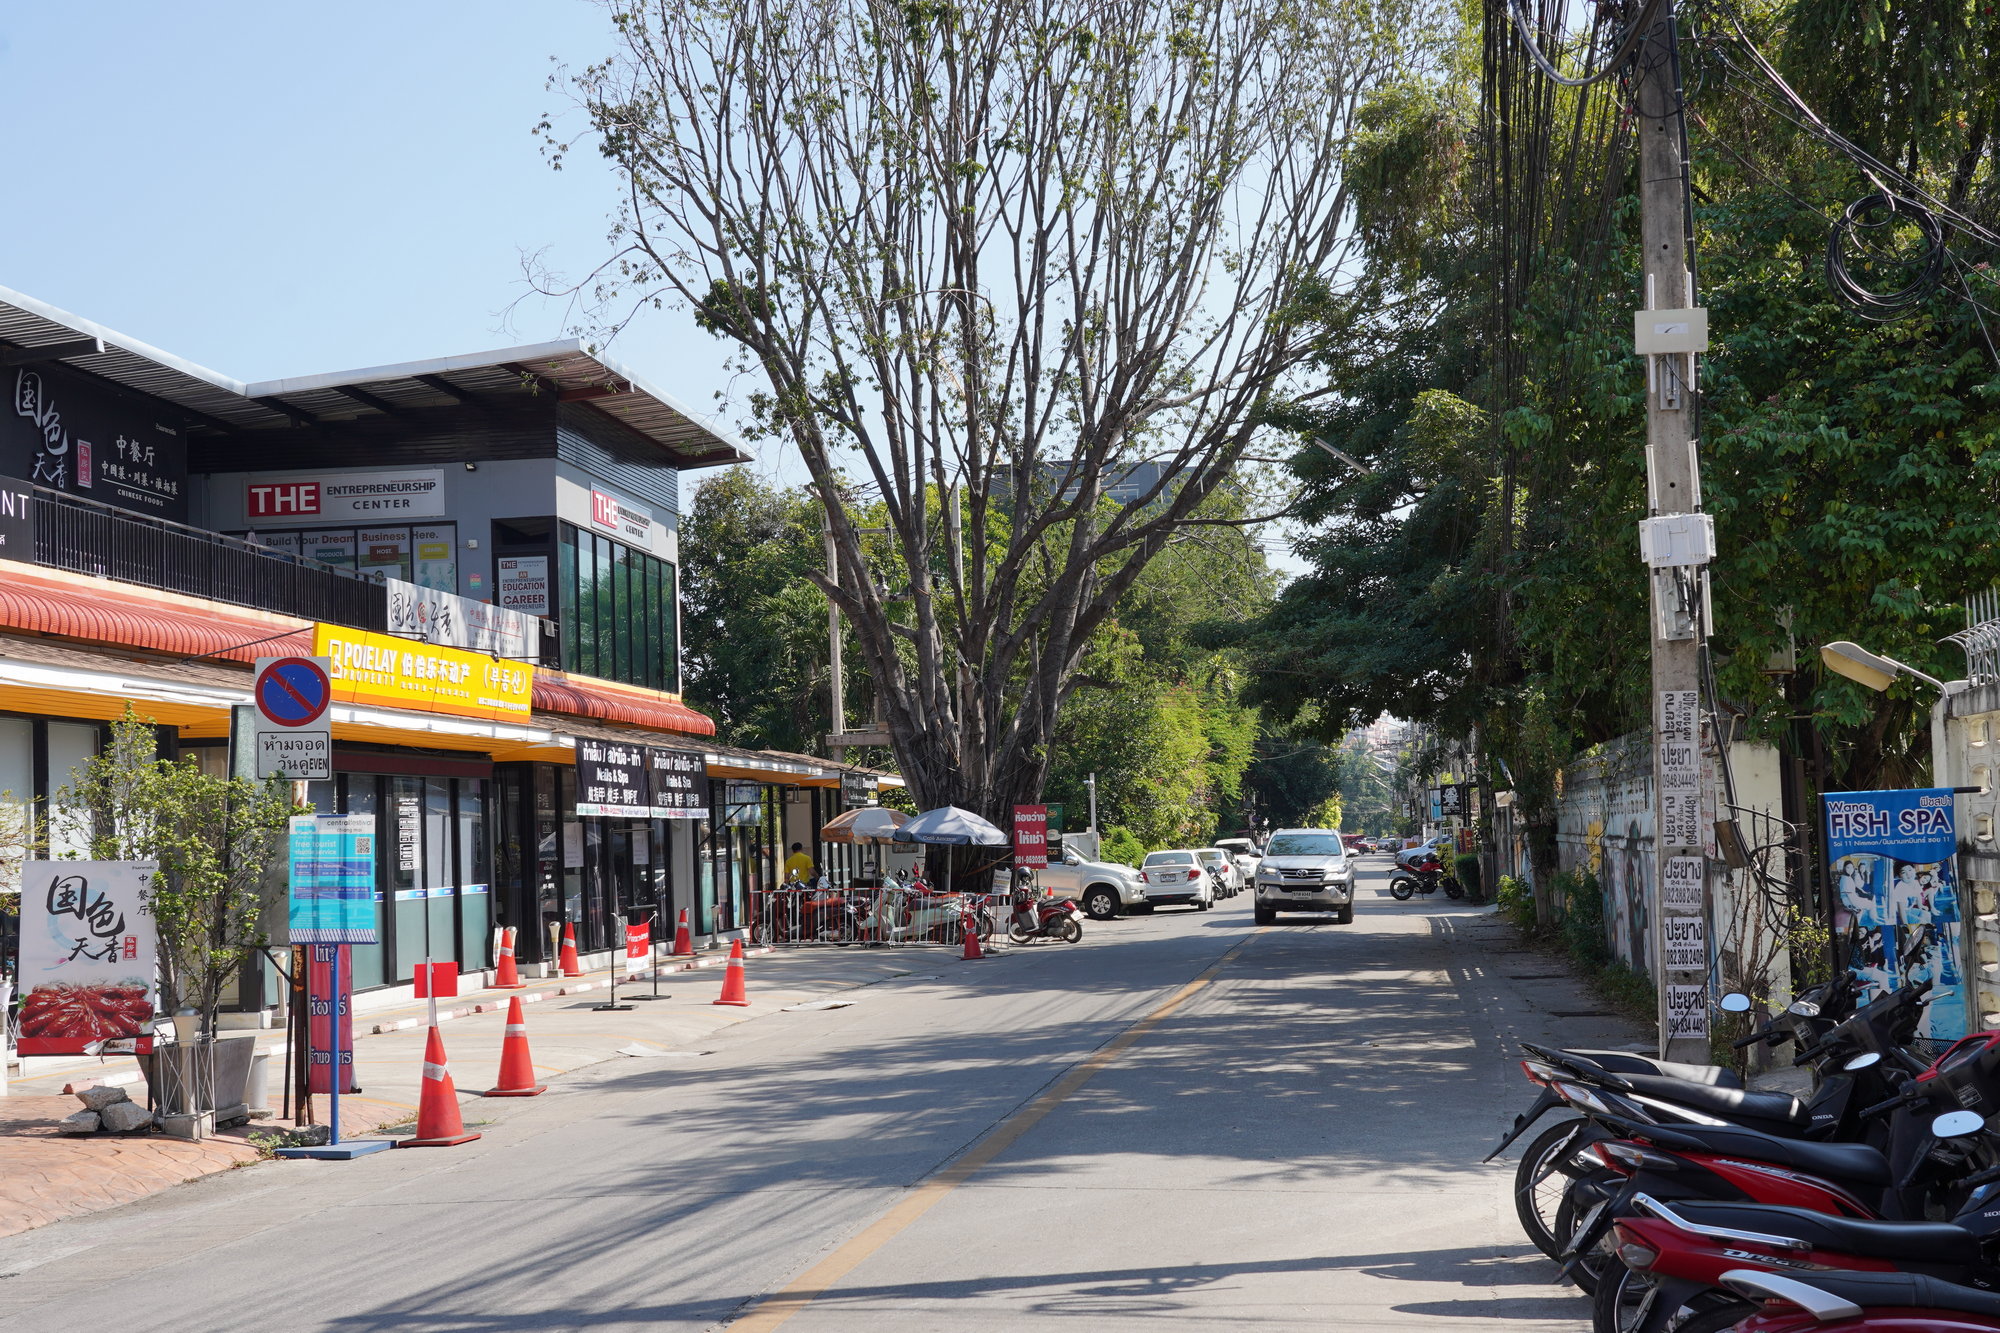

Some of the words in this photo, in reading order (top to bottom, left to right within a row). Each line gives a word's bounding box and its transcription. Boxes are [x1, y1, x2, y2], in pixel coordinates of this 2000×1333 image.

[116, 434, 155, 467] 中餐厅
[117, 489, 143, 501] CHINESE
[144, 496, 164, 507] FOODS
[326, 482, 437, 495] ENTREPRENEURSHIP
[251, 485, 317, 513] THE
[352, 499, 411, 510] CENTER
[595, 493, 618, 526] THE
[265, 536, 292, 547] Build
[293, 537, 319, 546] Your
[321, 535, 356, 545] Dream
[361, 532, 407, 543] Business
[411, 530, 439, 540] Here.
[502, 582, 545, 591] EDUCATION
[503, 594, 545, 605] CAREER
[342, 668, 395, 687] PROPERTY
[1663, 693, 1675, 741] ปะยาง
[1675, 720, 1683, 733] 24
[263, 735, 325, 751] ห้ามจอด
[309, 758, 328, 770] EVEN
[1662, 743, 1698, 766] ปะยา
[596, 767, 612, 782] Nails
[613, 769, 618, 783] &
[617, 769, 629, 786] Spa
[1663, 796, 1676, 846] ปะยาง
[1676, 824, 1684, 837] 24
[1830, 811, 1890, 838] FISH
[1898, 808, 1953, 835] SPA
[295, 840, 311, 848] free
[1666, 859, 1702, 880] ปะยาง
[137, 873, 149, 917] 中餐厅
[1666, 918, 1703, 941] ปะยาง
[1667, 986, 1705, 1010] ปะยาง
[1723, 1248, 1815, 1269] Dream
